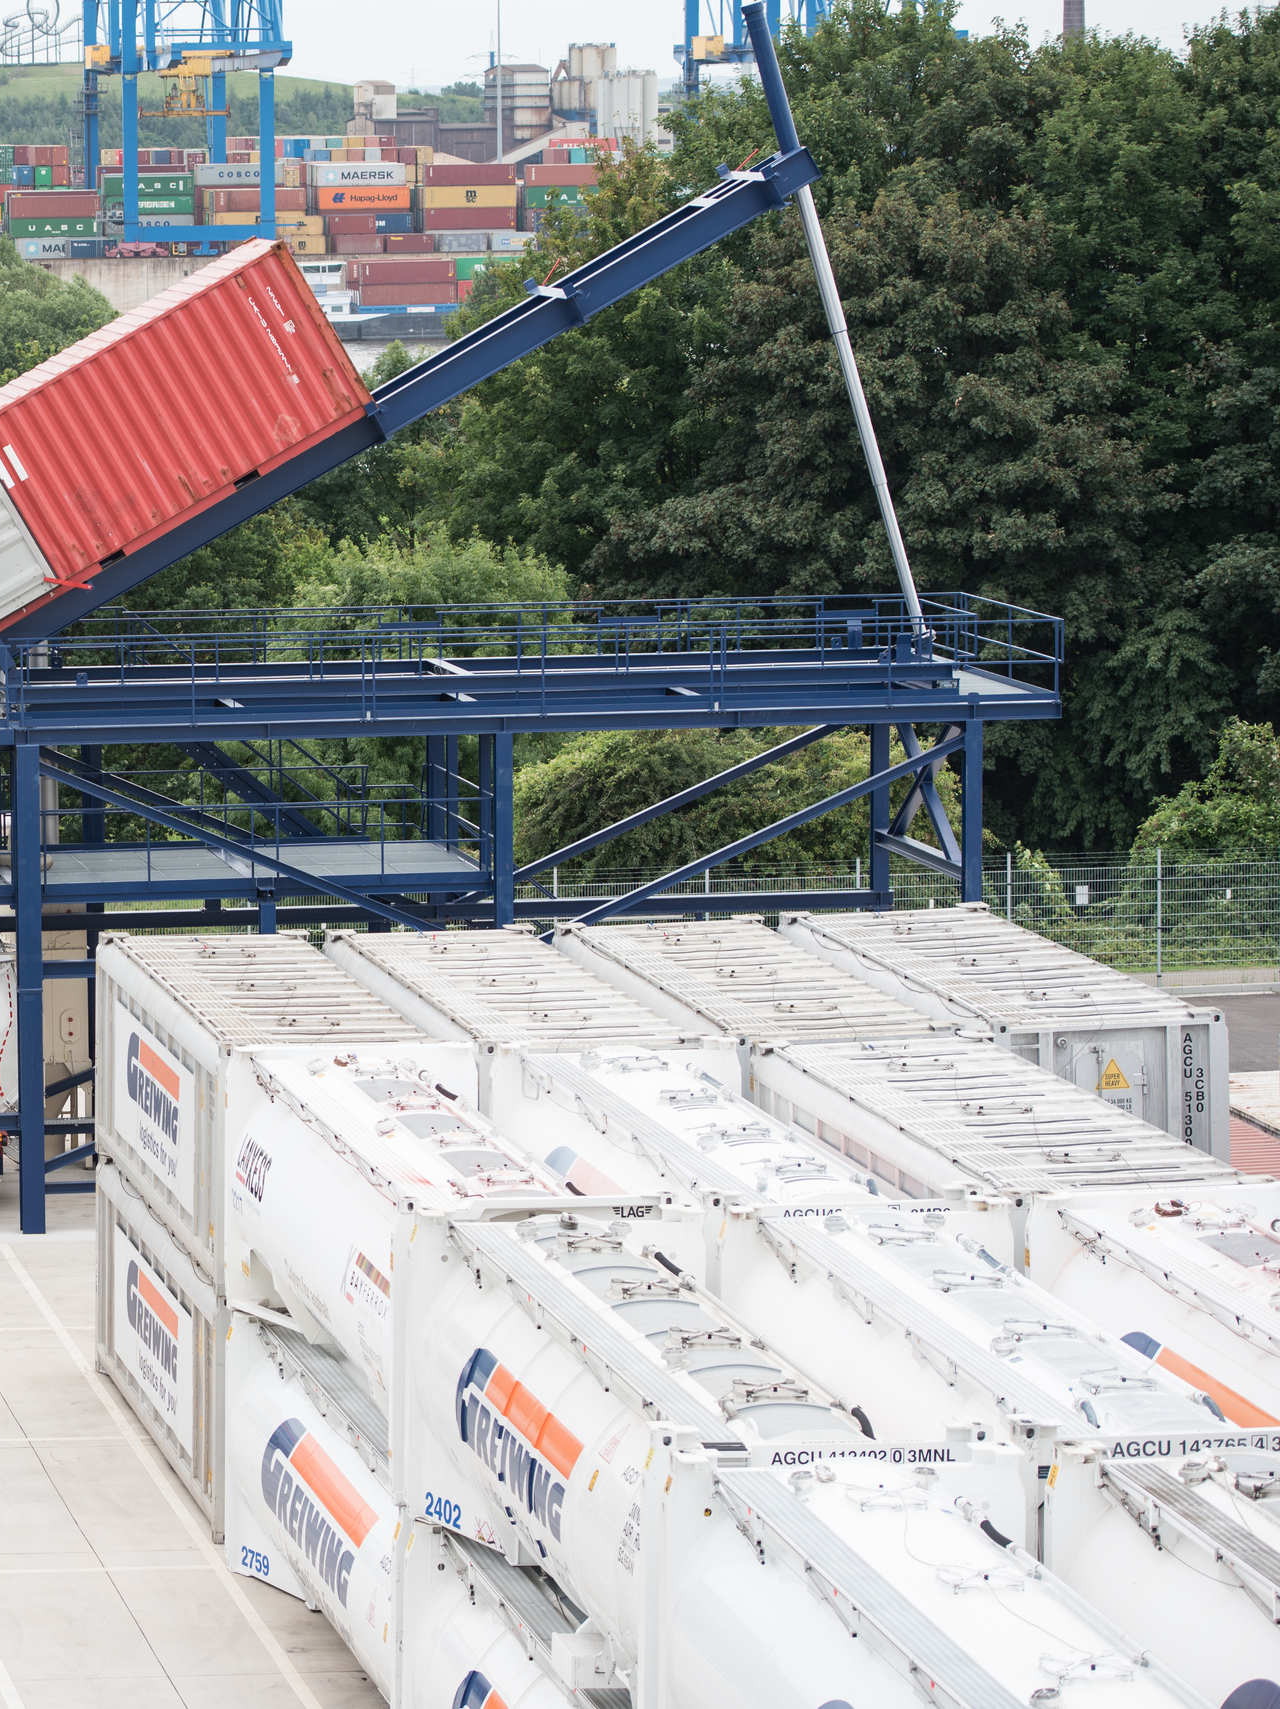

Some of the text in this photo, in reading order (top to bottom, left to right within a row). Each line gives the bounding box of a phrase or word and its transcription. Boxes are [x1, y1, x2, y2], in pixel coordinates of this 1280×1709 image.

[218, 170, 261, 178] COSCO
[341, 170, 394, 180] MAERSK
[350, 193, 398, 204] Hapag-Lloyd
[28, 223, 83, 231] UASC
[266, 286, 285, 316] 22G1
[248, 296, 267, 327] CAIU
[266, 328, 292, 373] 283577
[1183, 1032, 1193, 1079] AGCU
[127, 1032, 179, 1146] GREIWING
[1195, 1067, 1205, 1113] 3CB0
[139, 1119, 159, 1159] logistics
[237, 1133, 273, 1203] LANXESS
[621, 1206, 644, 1218] LAG
[350, 1270, 389, 1320] BAYFERROX
[126, 1259, 178, 1384] GREIWING
[139, 1348, 158, 1392] logistics
[455, 1347, 566, 1544] GREIWING
[771, 1451, 823, 1466] AGCU
[907, 1448, 957, 1463] 3MNL
[1112, 1440, 1171, 1457] AGCU
[261, 1417, 356, 1610] GREIWING
[425, 1491, 462, 1530] 2402
[241, 1545, 270, 1577] 2759
